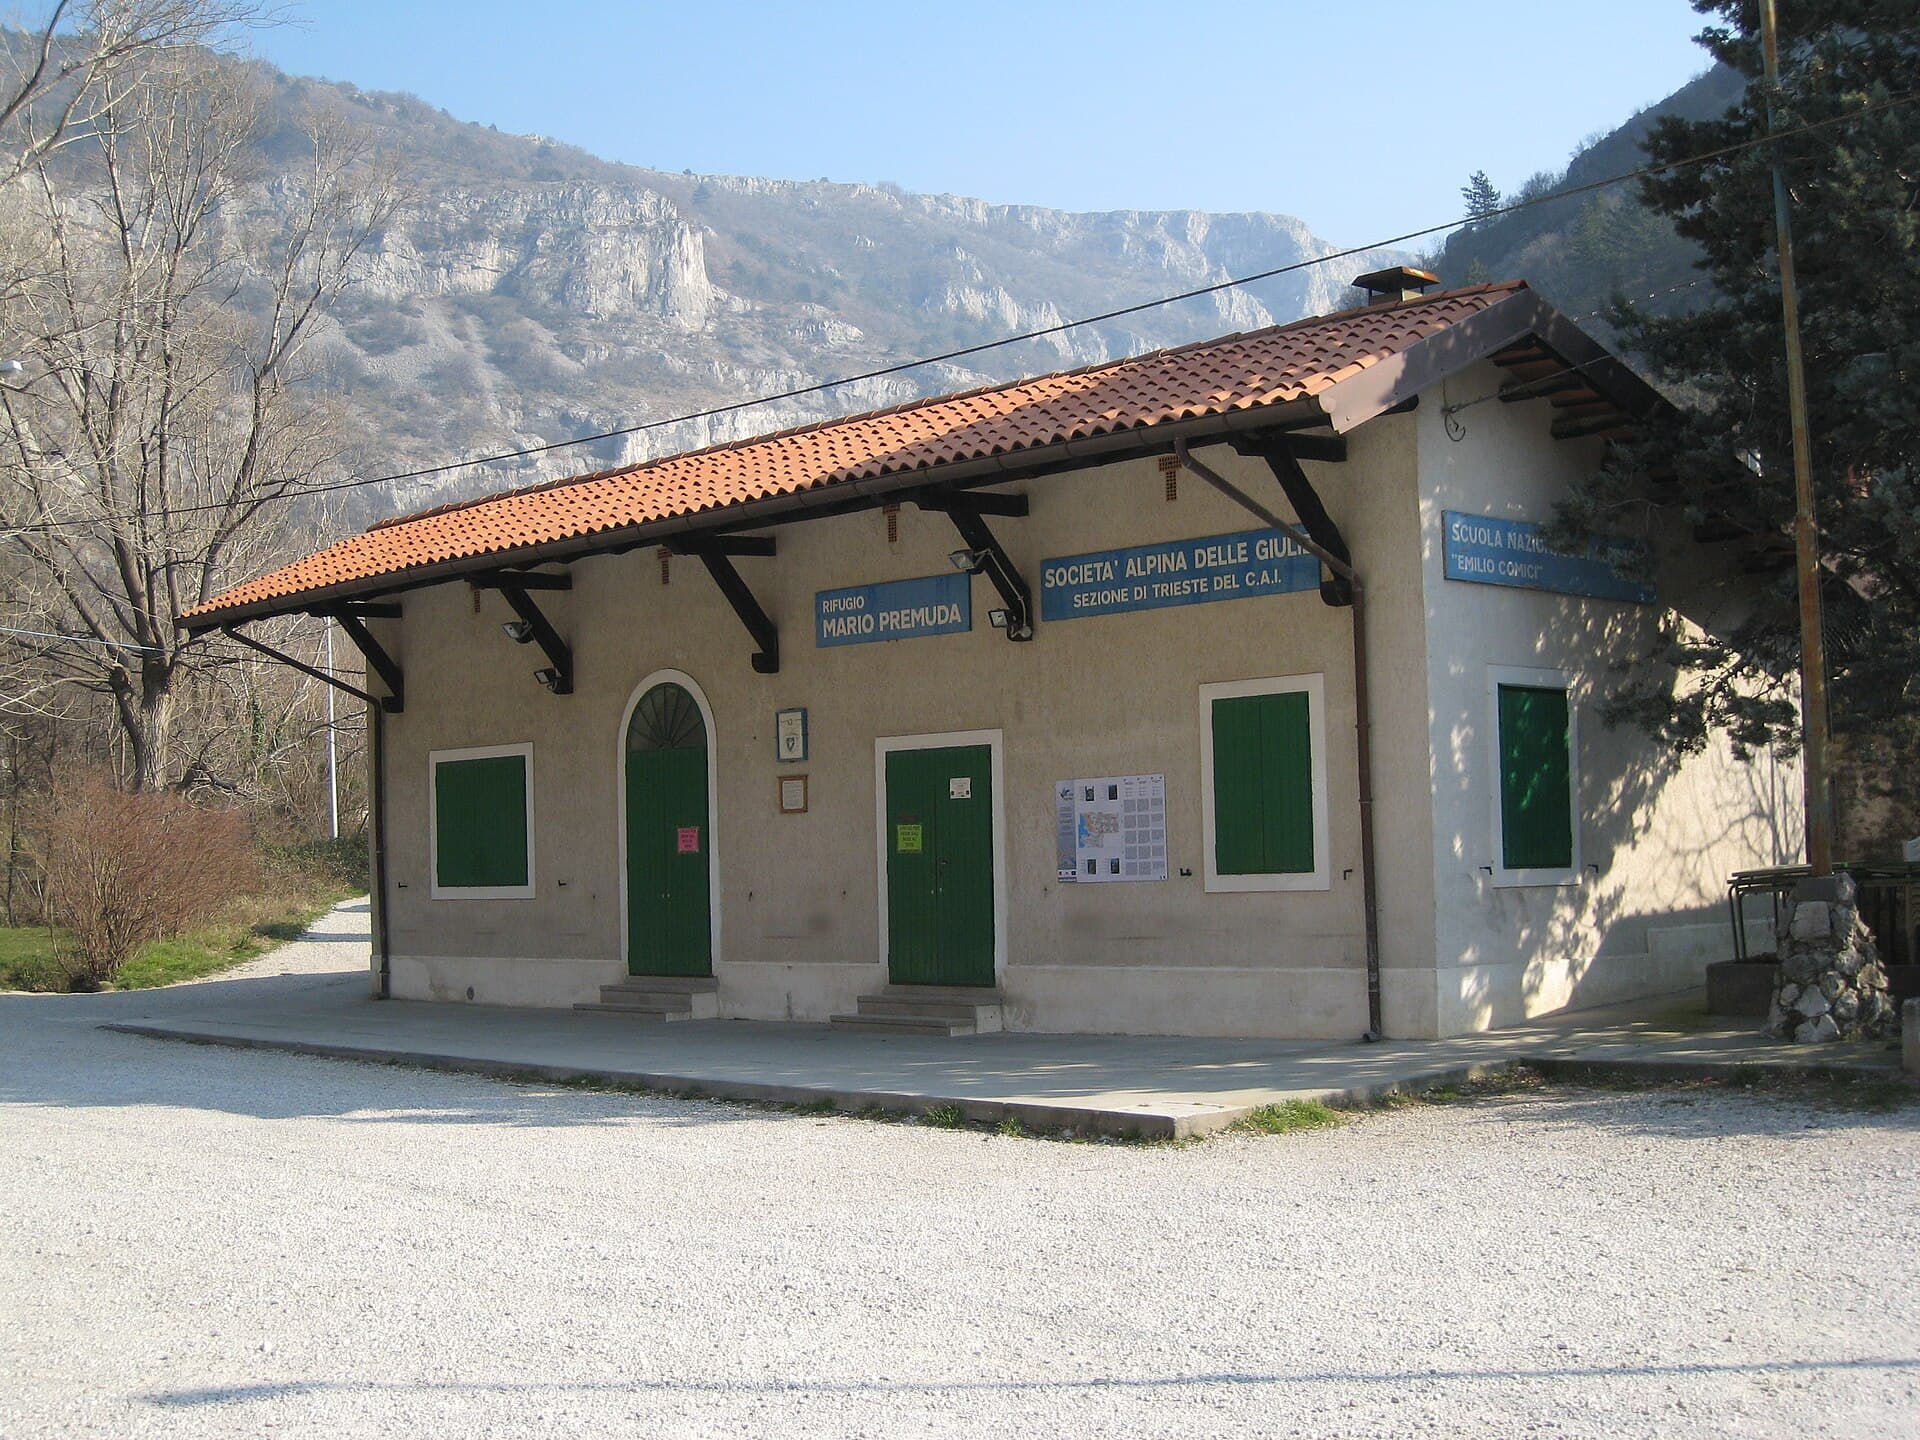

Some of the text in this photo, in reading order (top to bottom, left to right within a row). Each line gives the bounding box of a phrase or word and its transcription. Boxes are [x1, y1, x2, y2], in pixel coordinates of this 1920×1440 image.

[1452, 522, 1503, 548] SCUOLA
[1044, 560, 1119, 588] SOCIETA'
[1124, 550, 1188, 578] ALPINA
[1194, 541, 1248, 569] DELLE
[1452, 553, 1495, 574] "EMILIO
[822, 595, 865, 613] RIFUGIO
[1073, 569, 1282, 609] SEZIONE DI TRIESTE DEL C.A.I.
[822, 603, 962, 639] MARIO PREMUDA
